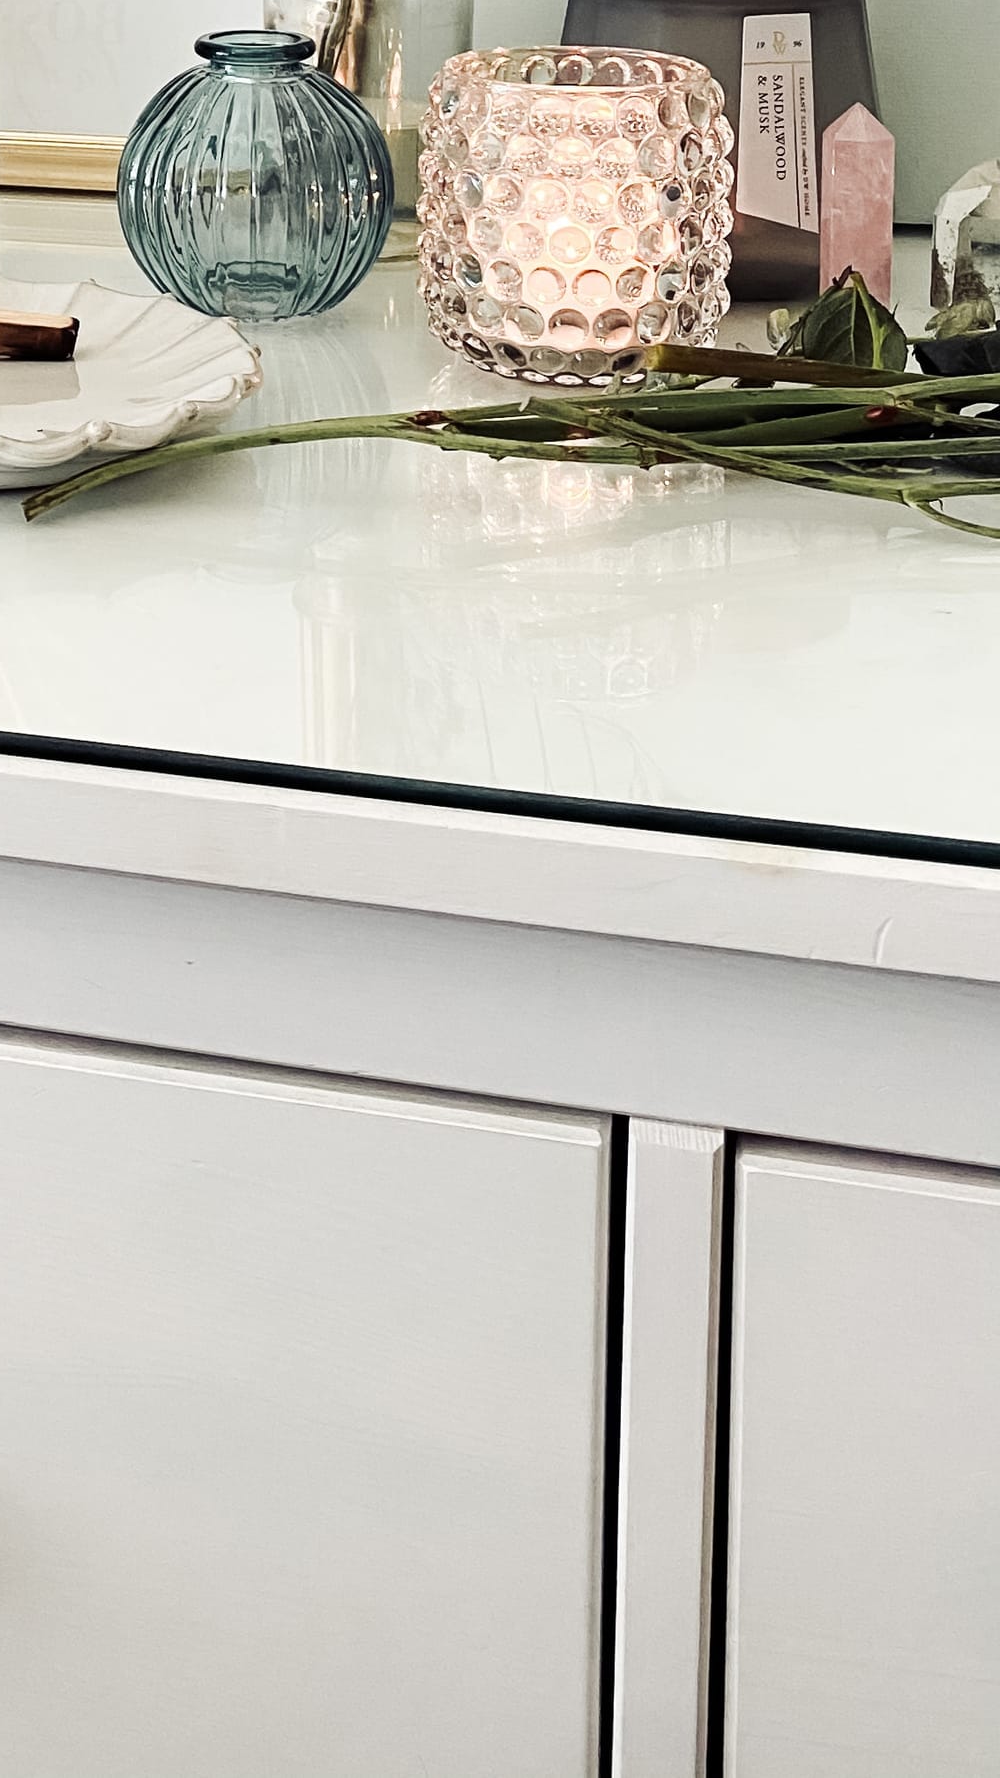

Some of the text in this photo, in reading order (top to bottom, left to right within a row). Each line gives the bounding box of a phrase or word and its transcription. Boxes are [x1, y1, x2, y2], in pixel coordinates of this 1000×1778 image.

[757, 75, 770, 134] & MUSK
[772, 74, 787, 181] SANDALWOOD
[799, 77, 807, 113] ELEGANT
[803, 176, 809, 190] DW
